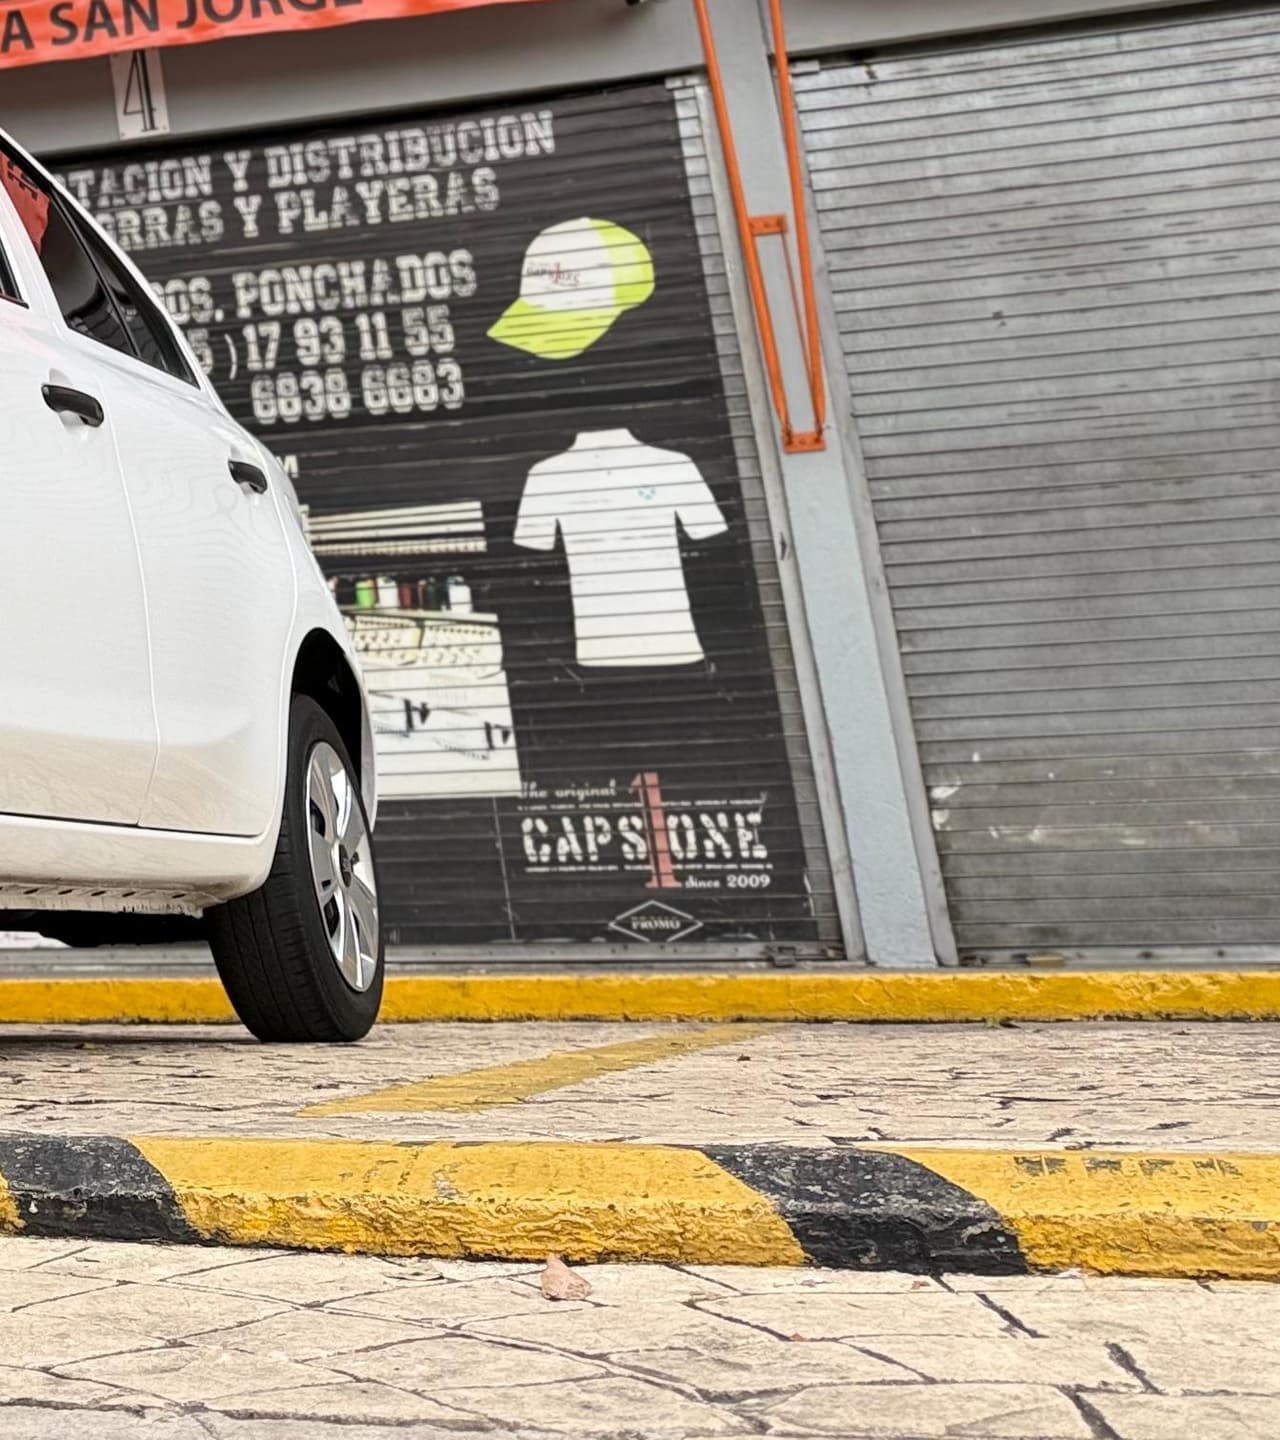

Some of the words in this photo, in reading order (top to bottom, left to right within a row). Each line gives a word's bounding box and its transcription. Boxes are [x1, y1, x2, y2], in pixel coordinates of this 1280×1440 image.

[123, 50, 159, 133] 4
[223, 149, 251, 192] Y
[264, 110, 556, 188] DISTRIBUCION
[233, 194, 262, 238] Y
[274, 167, 501, 234] PLAYERAS
[243, 321, 281, 371] 17
[294, 315, 346, 365] 93
[356, 311, 393, 360] 11
[401, 305, 455, 356] 55
[727, 874, 771, 888] 2009
